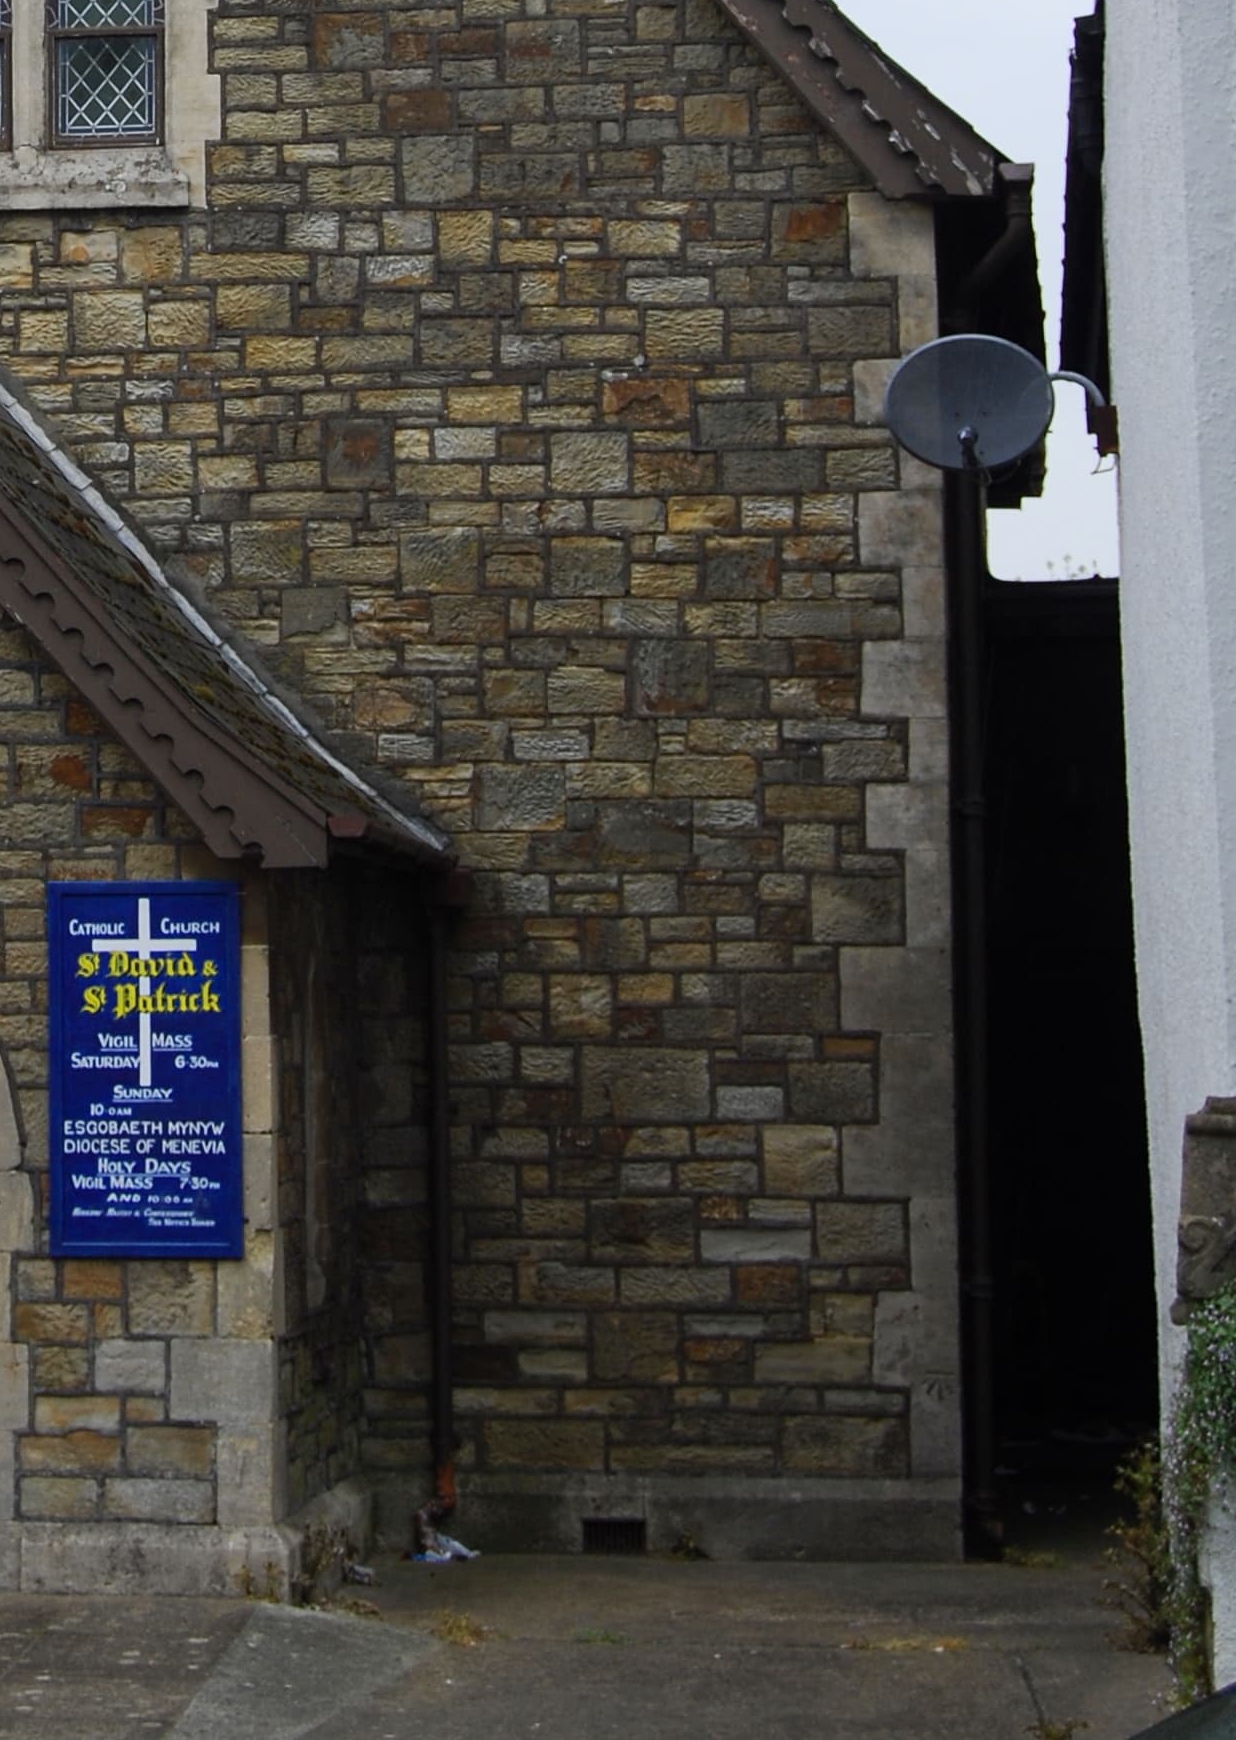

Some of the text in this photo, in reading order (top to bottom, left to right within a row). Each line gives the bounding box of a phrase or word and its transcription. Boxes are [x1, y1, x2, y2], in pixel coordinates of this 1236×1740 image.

[69, 917, 220, 935] CATHOLIC CHURCH
[105, 950, 197, 977] David
[202, 959, 218, 977] &
[112, 980, 221, 1020] Patrick
[97, 1032, 193, 1048] VIGIL MASS
[71, 1052, 140, 1069] SATURDAY
[113, 1084, 173, 1099] SUNDAY
[64, 1120, 225, 1136] ESGOBAETH MYNYW
[64, 1139, 226, 1154] DIOCESE OF MENEVIA
[98, 1157, 191, 1174] HOLY DAYS
[71, 1174, 106, 1190] VIGIL
[110, 1174, 153, 1190] MASS
[106, 1192, 141, 1203] AND
